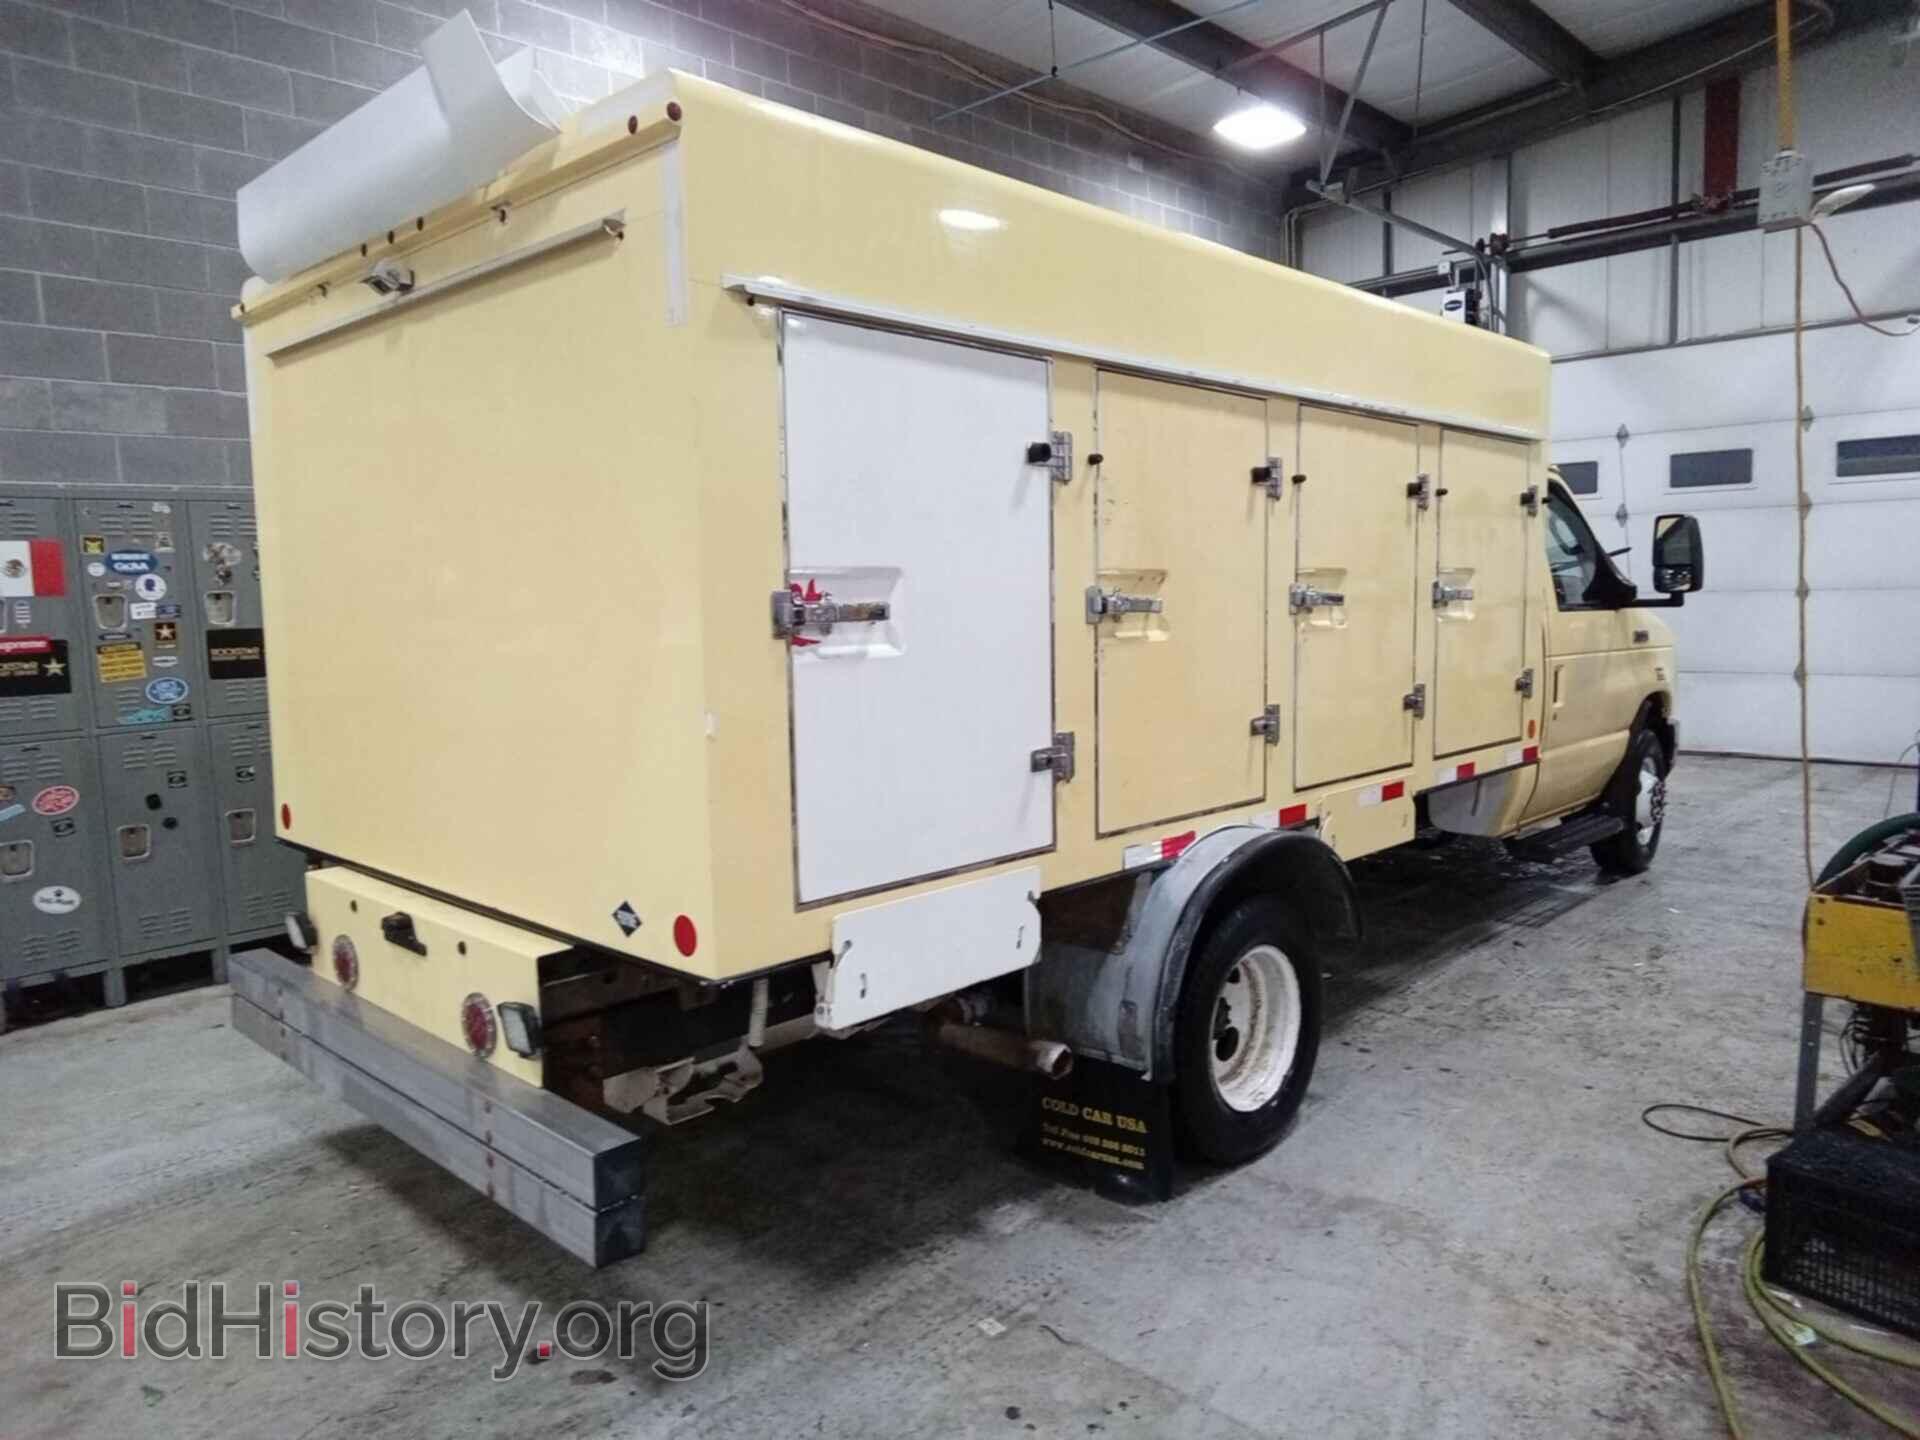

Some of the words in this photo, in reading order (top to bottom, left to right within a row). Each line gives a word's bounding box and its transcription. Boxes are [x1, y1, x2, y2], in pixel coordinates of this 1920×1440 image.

[1042, 1097, 1079, 1116] COLD
[1082, 1107, 1113, 1126] CAR
[1116, 1115, 1147, 1133] USA
